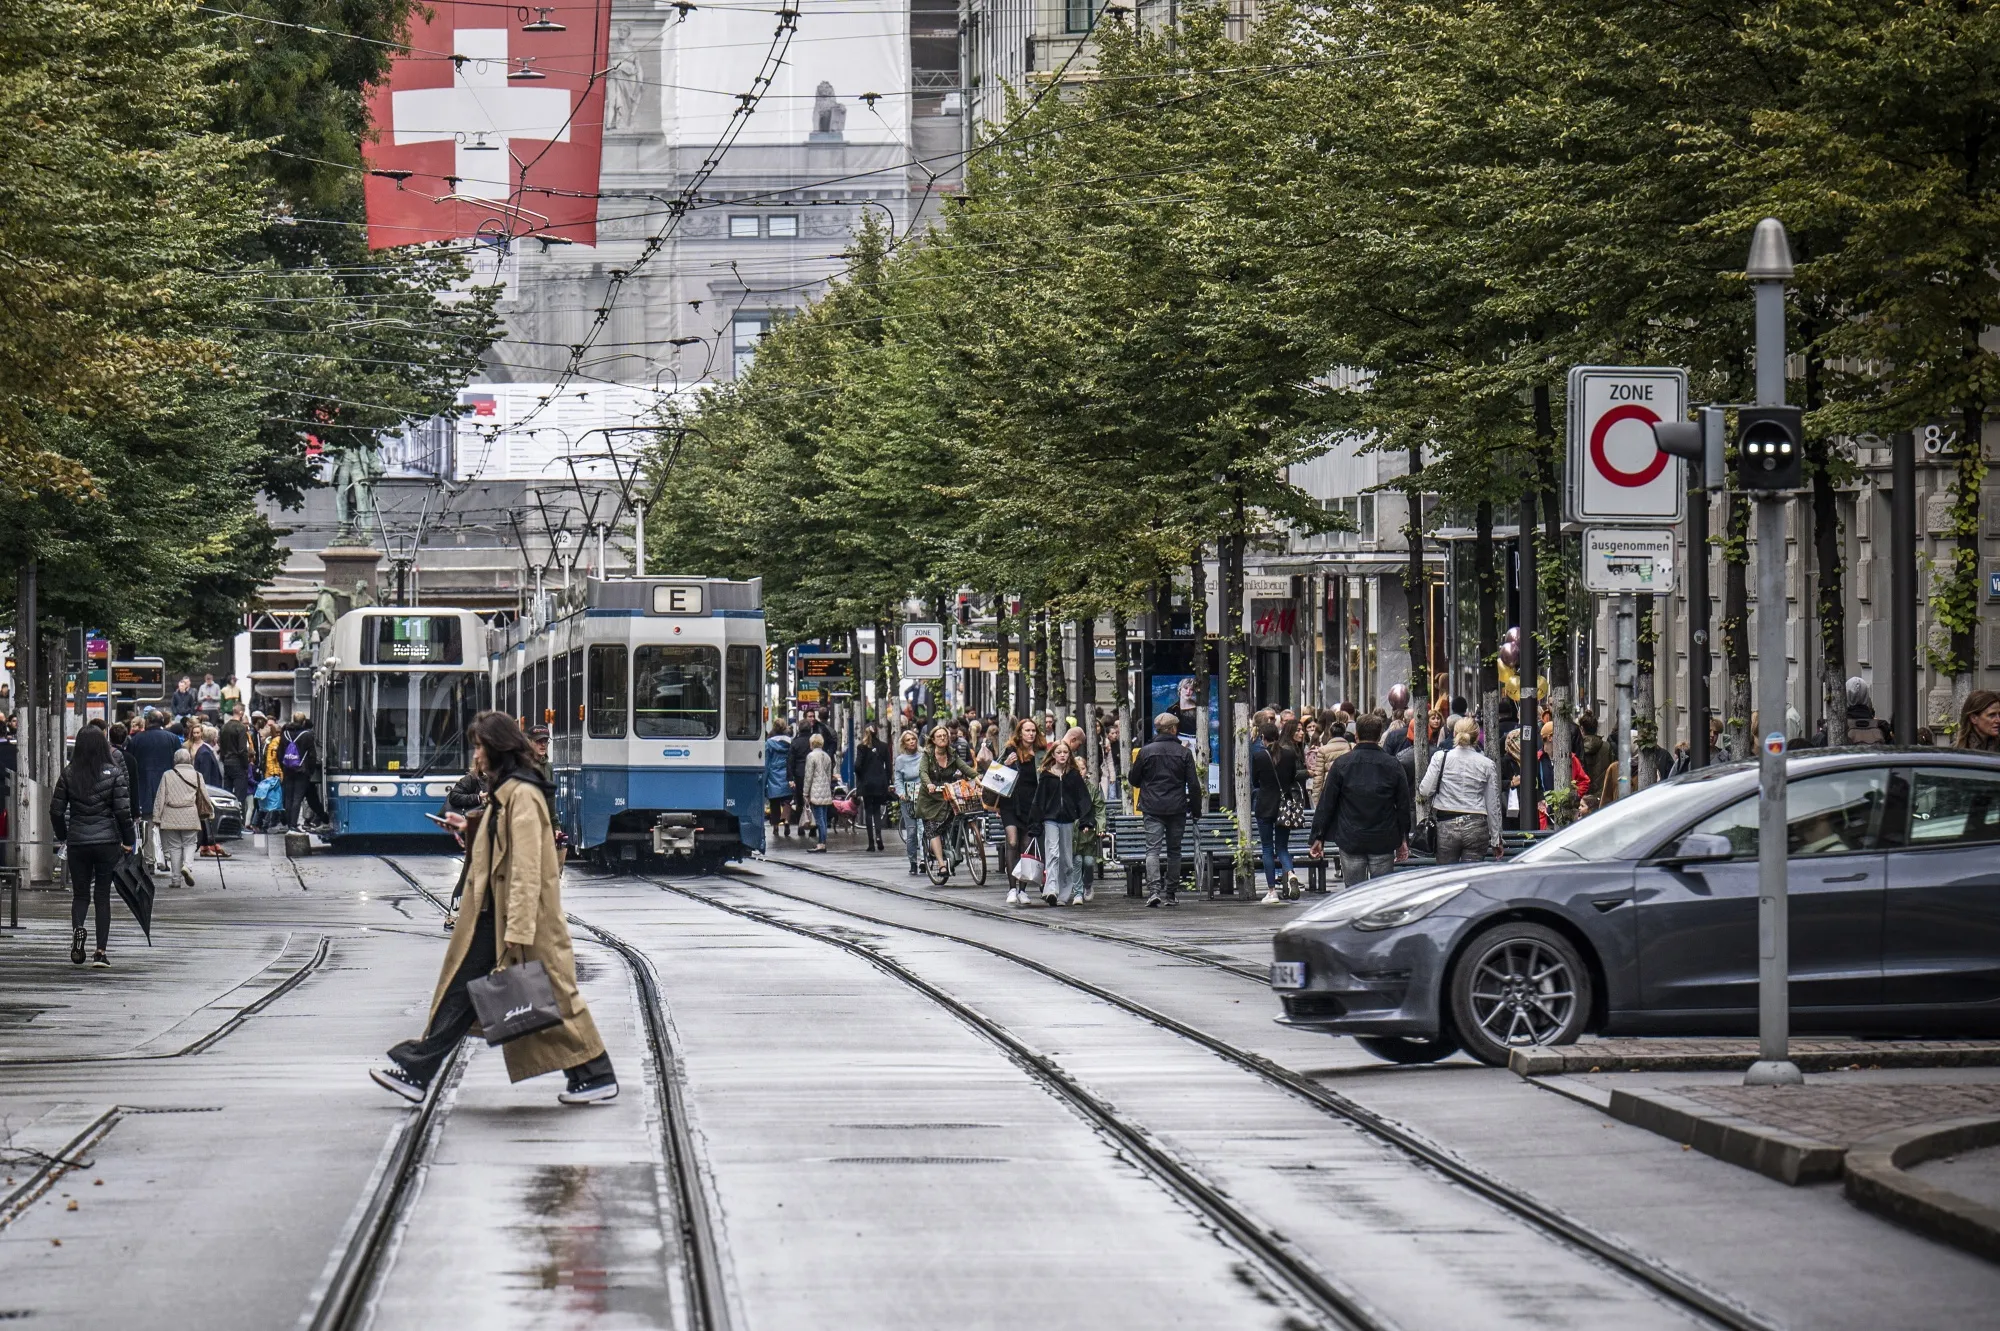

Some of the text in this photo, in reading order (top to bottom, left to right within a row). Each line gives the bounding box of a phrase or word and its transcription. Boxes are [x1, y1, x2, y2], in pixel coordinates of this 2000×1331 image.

[1609, 384, 1653, 400] ZONE
[1591, 540, 1669, 554] ausgenommen
[670, 589, 686, 611] E
[402, 619, 421, 637] 11
[1255, 608, 1297, 636] H&M
